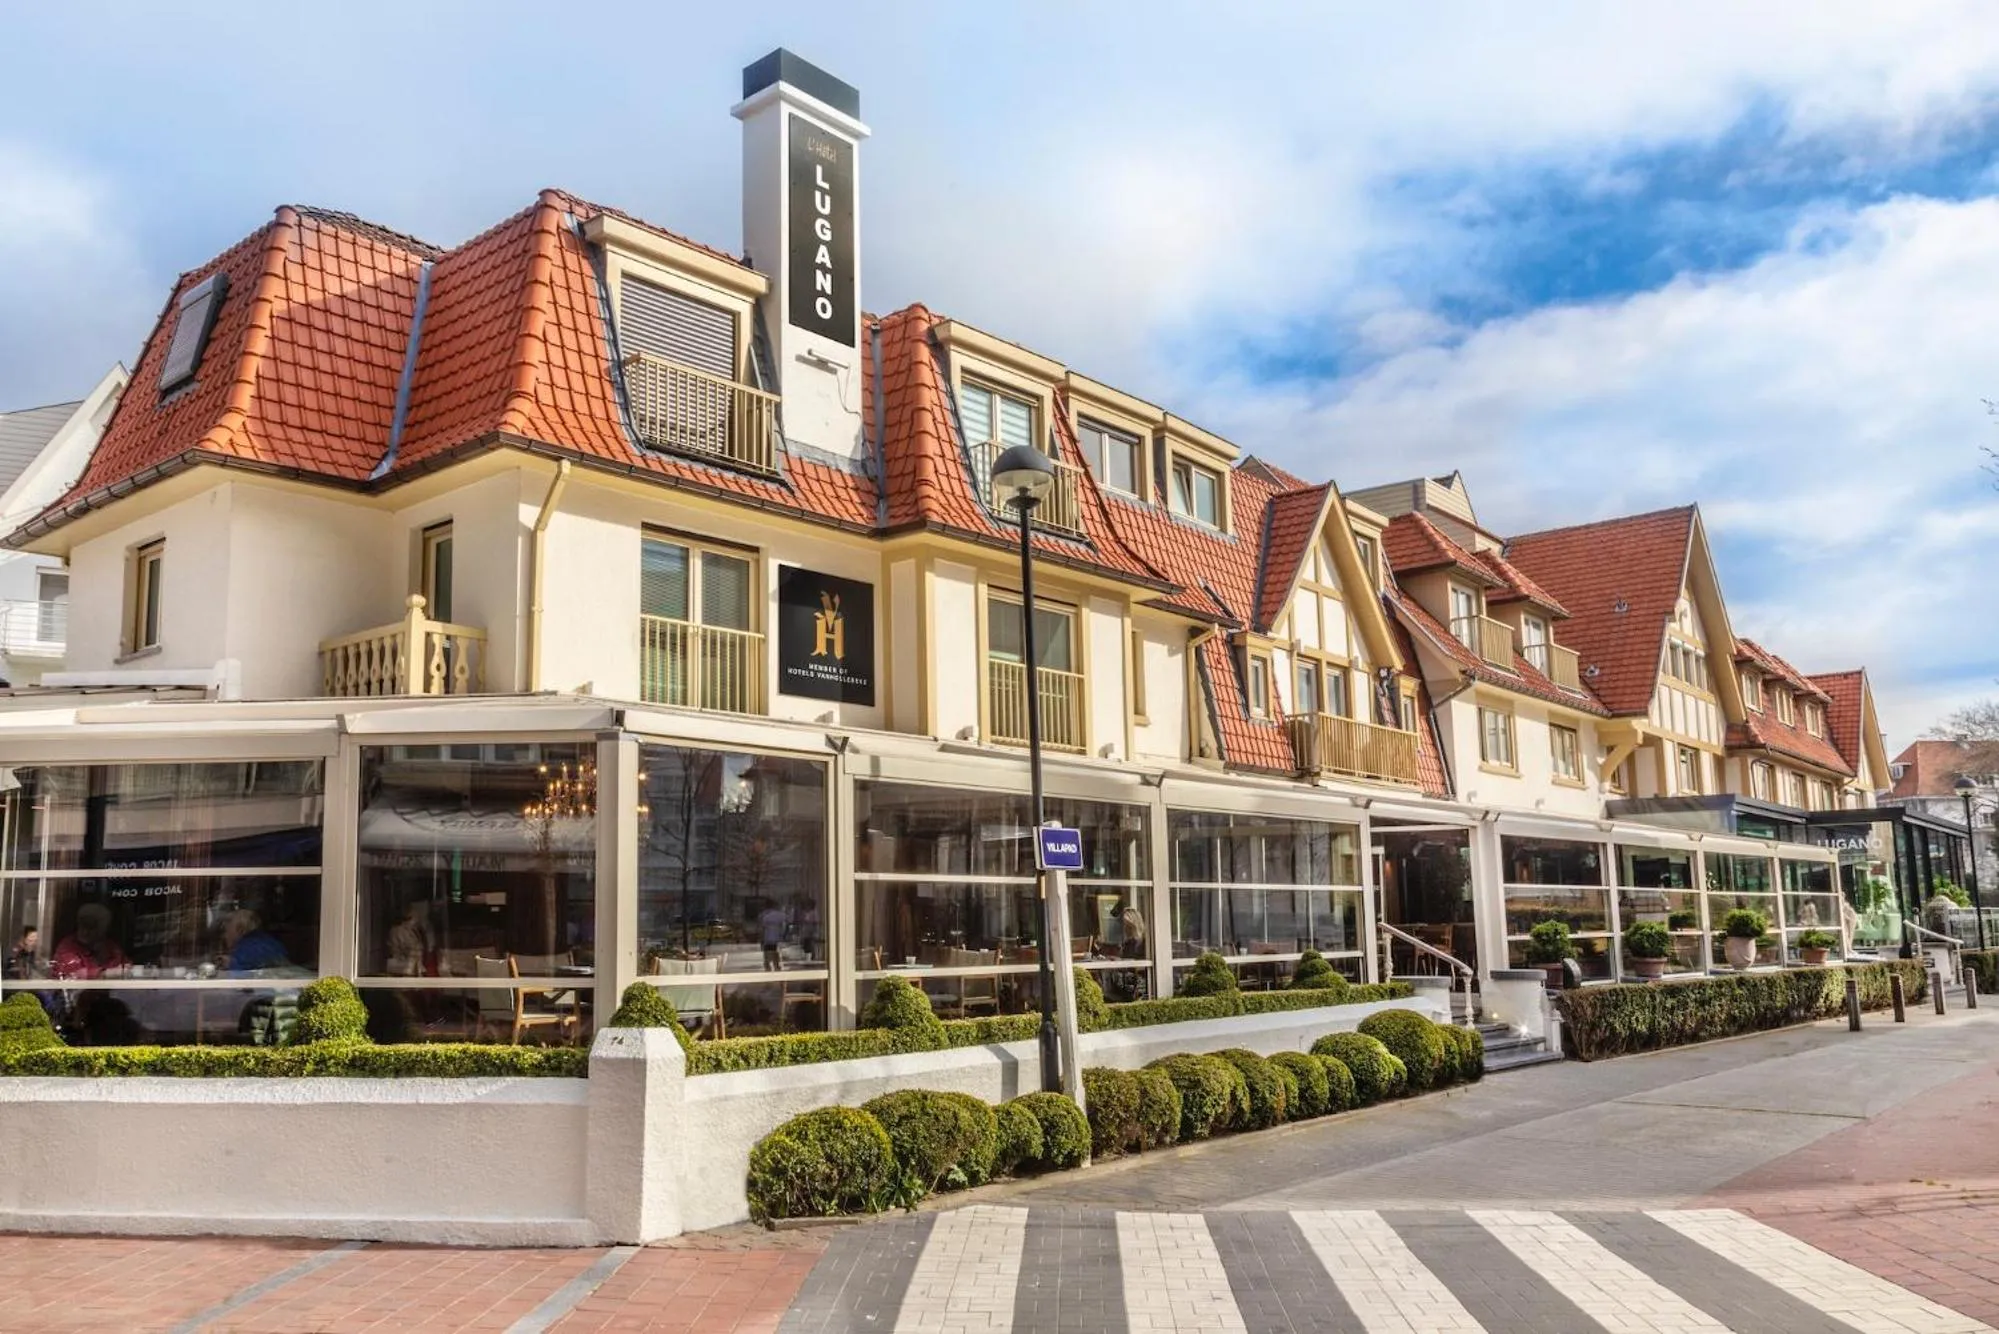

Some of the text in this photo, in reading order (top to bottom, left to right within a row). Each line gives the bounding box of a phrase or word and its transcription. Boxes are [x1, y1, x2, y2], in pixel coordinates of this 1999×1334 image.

[814, 163, 833, 320] LUGANO
[787, 667, 815, 678] HOTELS
[808, 663, 848, 675] MEMBER OF
